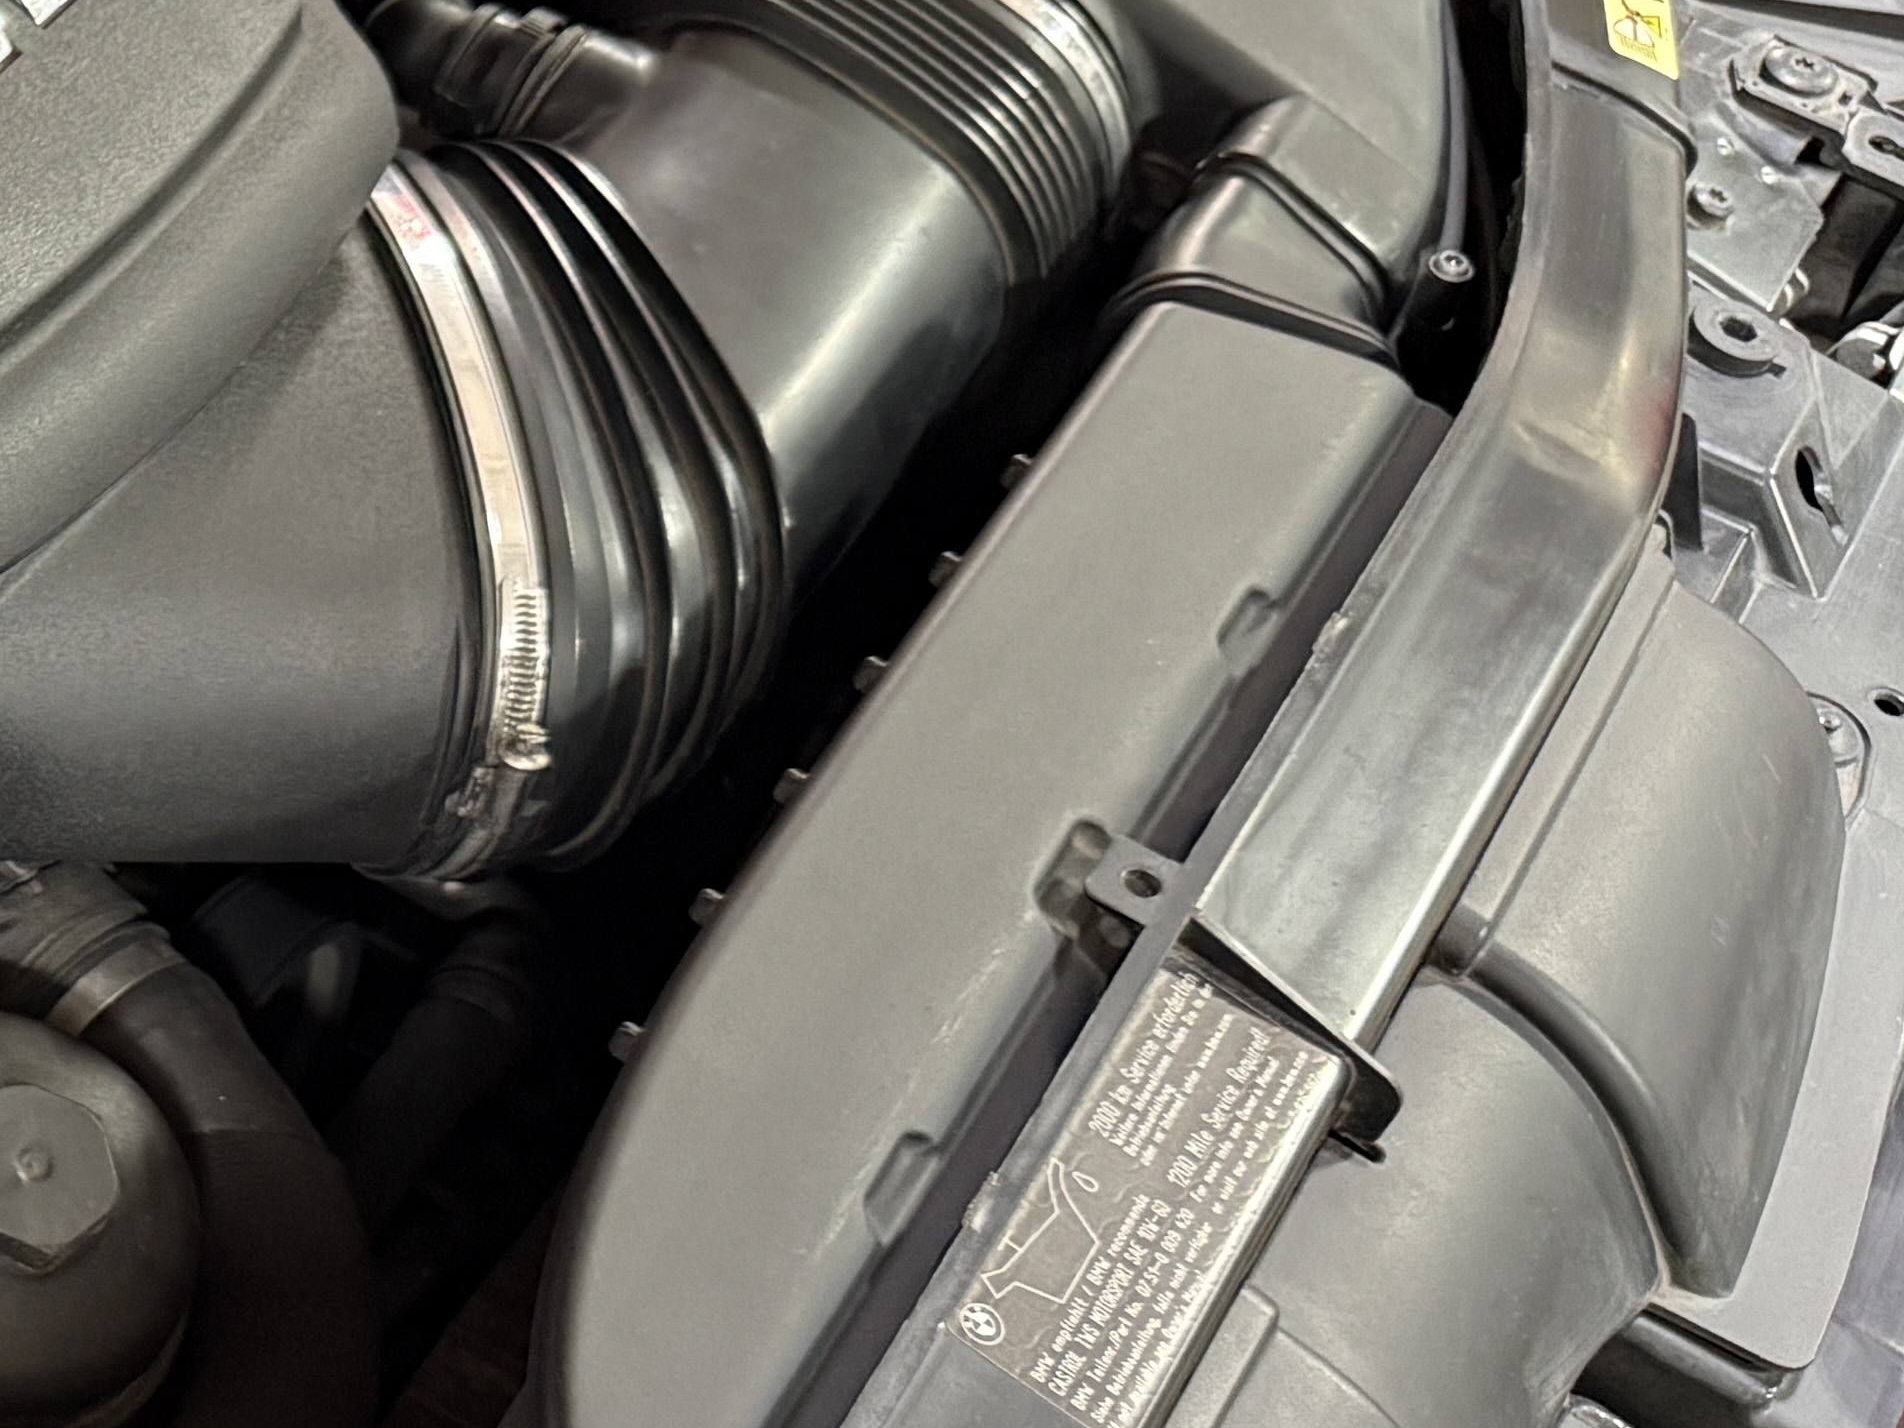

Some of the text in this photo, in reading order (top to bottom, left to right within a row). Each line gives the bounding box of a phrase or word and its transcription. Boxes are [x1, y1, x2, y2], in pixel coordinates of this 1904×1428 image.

[1088, 972, 1196, 1137] 2000 km Service erforderlich
[1166, 1026, 1270, 1187] 1200 Mile Service Required!
[1029, 1351, 1054, 1382] BMW
[1085, 1255, 1111, 1285] BMW
[1047, 1199, 1171, 1396] CASTROL TWS MOTORSPORT SAE 10W-60
[1070, 1382, 1094, 1410] BMW
